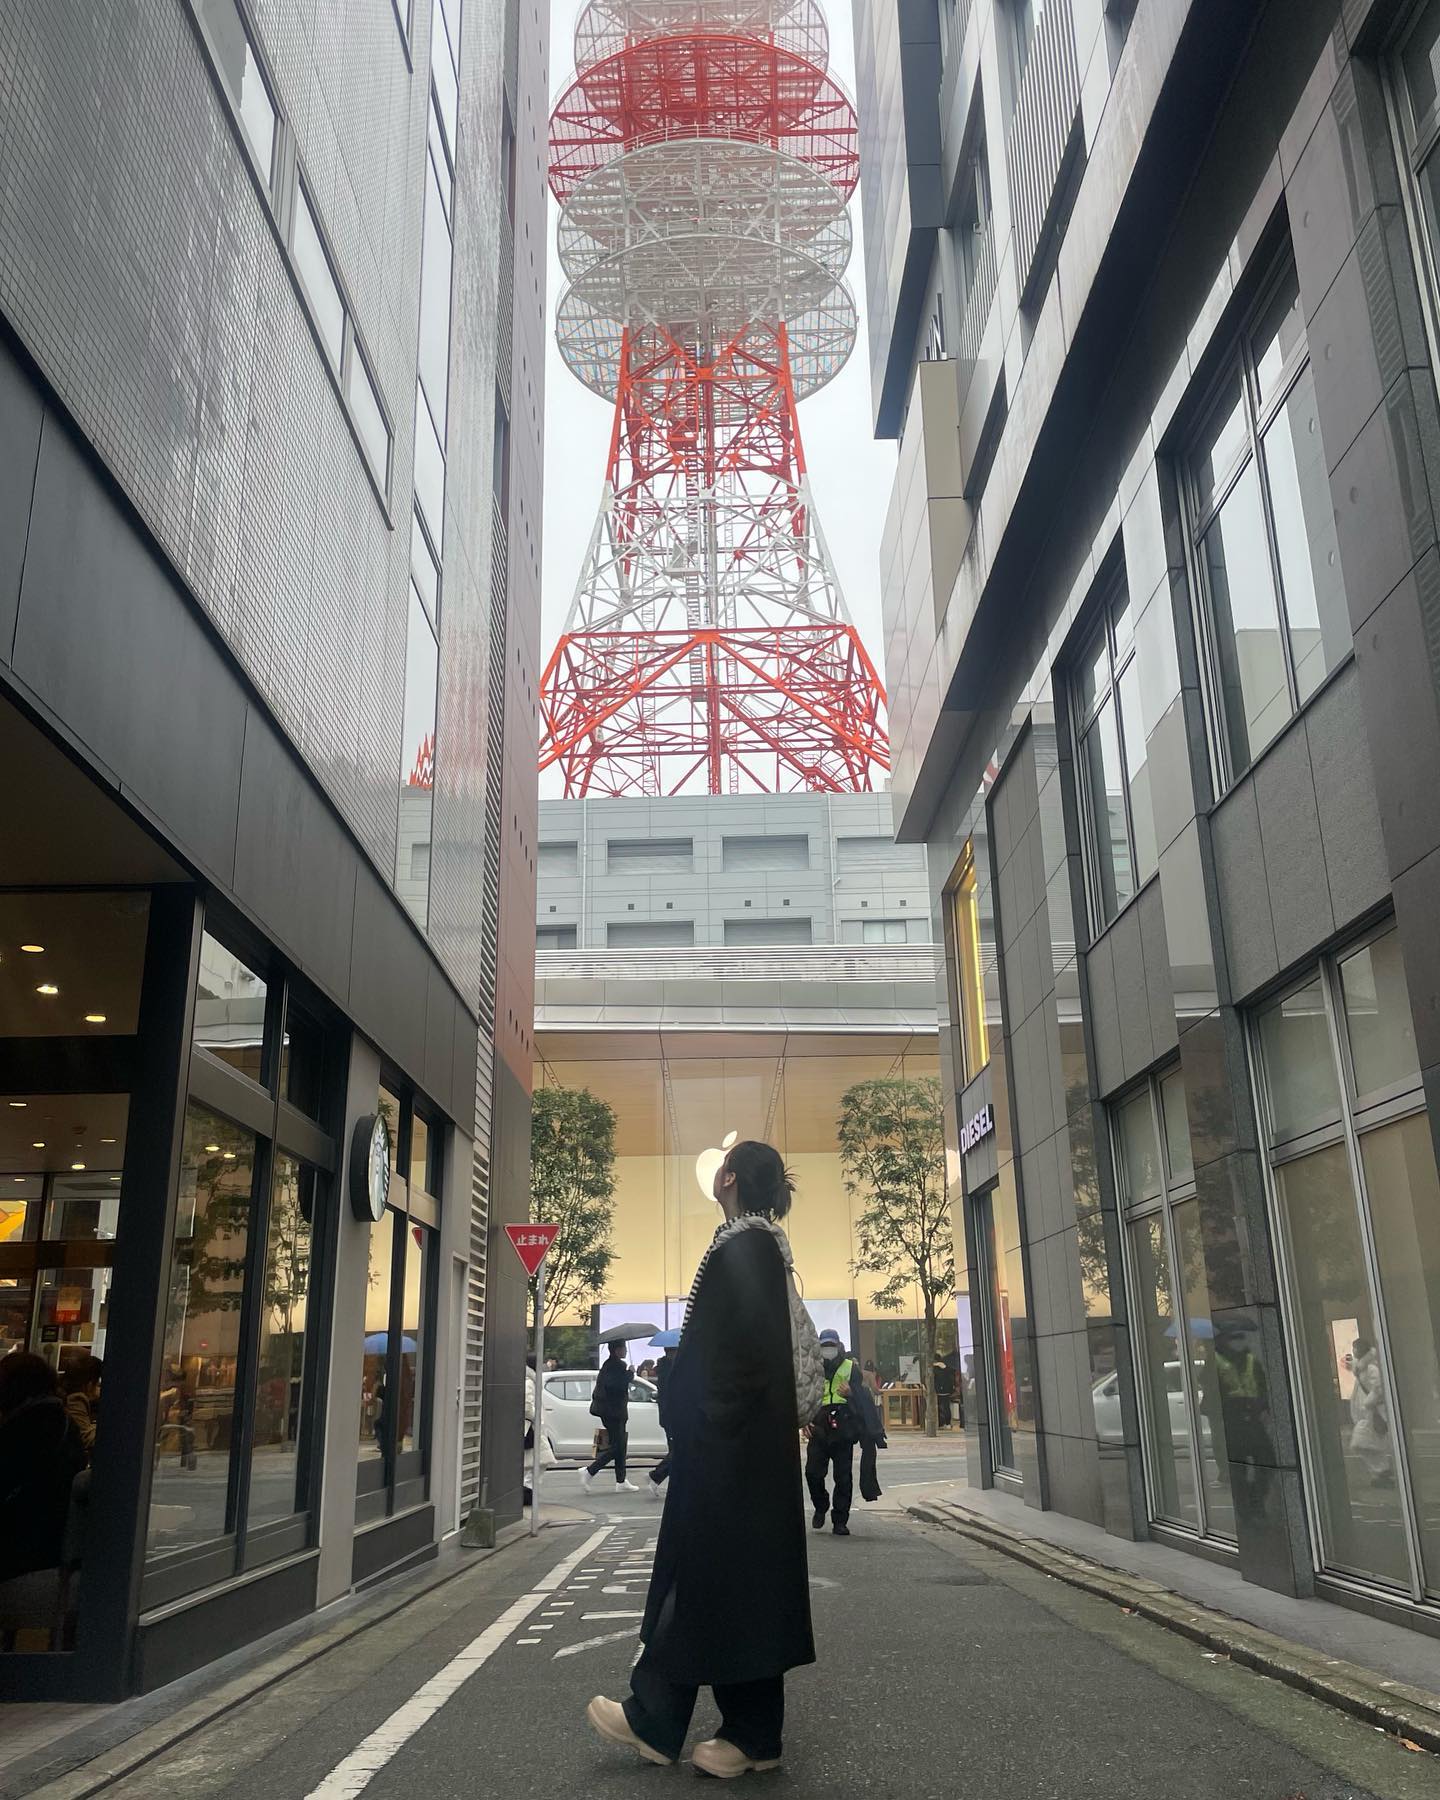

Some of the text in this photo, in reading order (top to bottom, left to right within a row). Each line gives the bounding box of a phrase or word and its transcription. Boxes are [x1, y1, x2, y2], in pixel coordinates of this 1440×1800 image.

[960, 1104, 993, 1154] DIESEL
[516, 1234, 549, 1246] 止まれ
